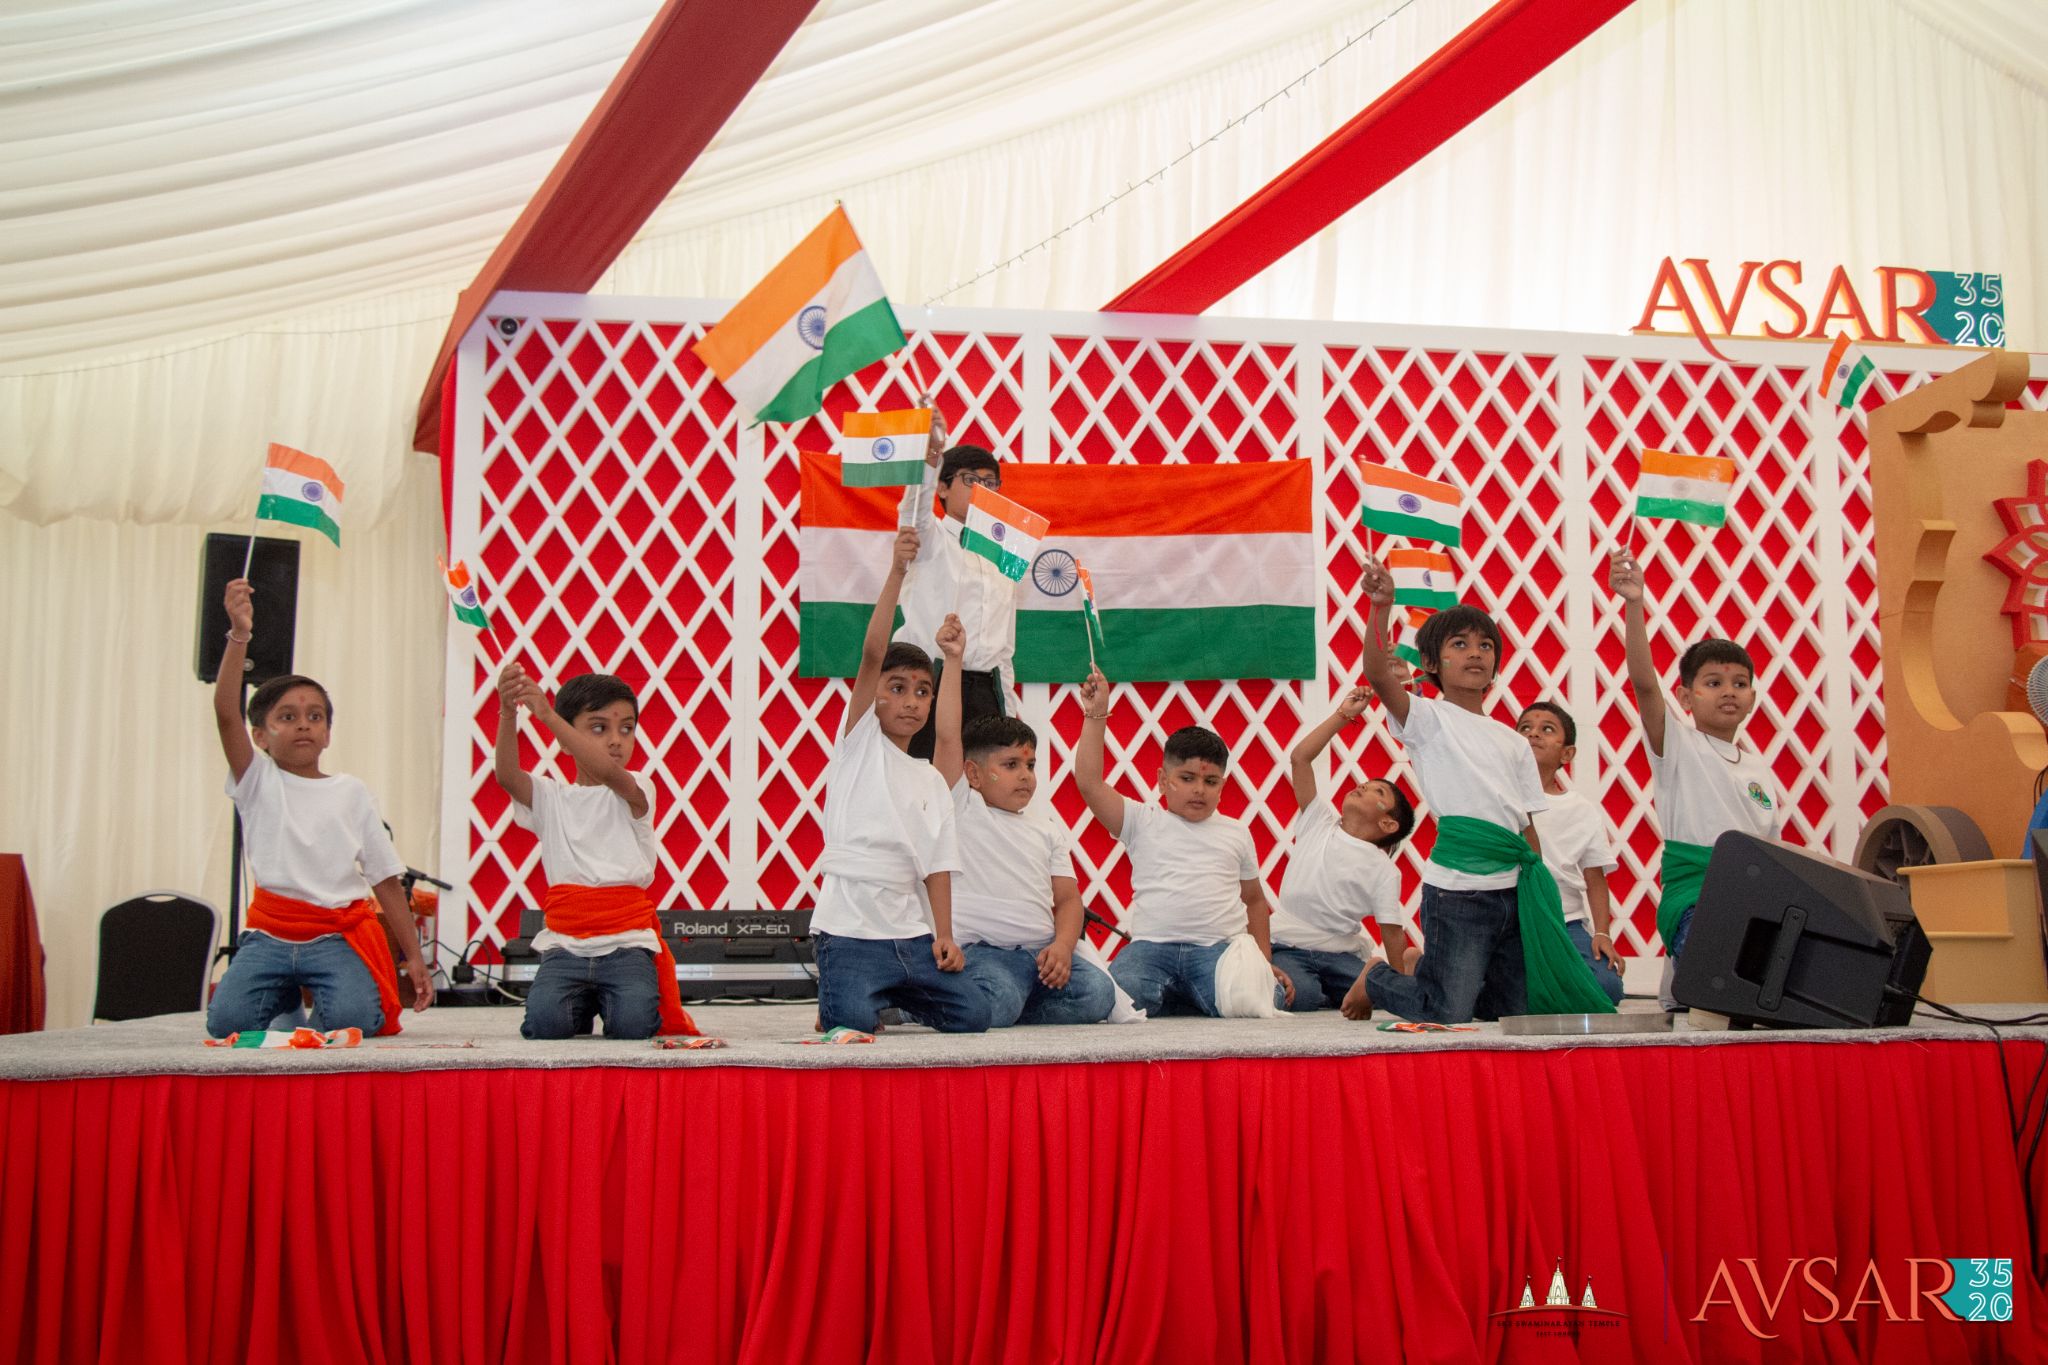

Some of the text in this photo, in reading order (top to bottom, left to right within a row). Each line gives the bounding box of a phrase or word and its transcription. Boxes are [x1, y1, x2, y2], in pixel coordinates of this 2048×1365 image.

[1954, 273, 2003, 307] 35
[1628, 256, 1950, 362] AVSAR
[1954, 311, 2005, 347] 20
[674, 922, 791, 935] Roland XP-60
